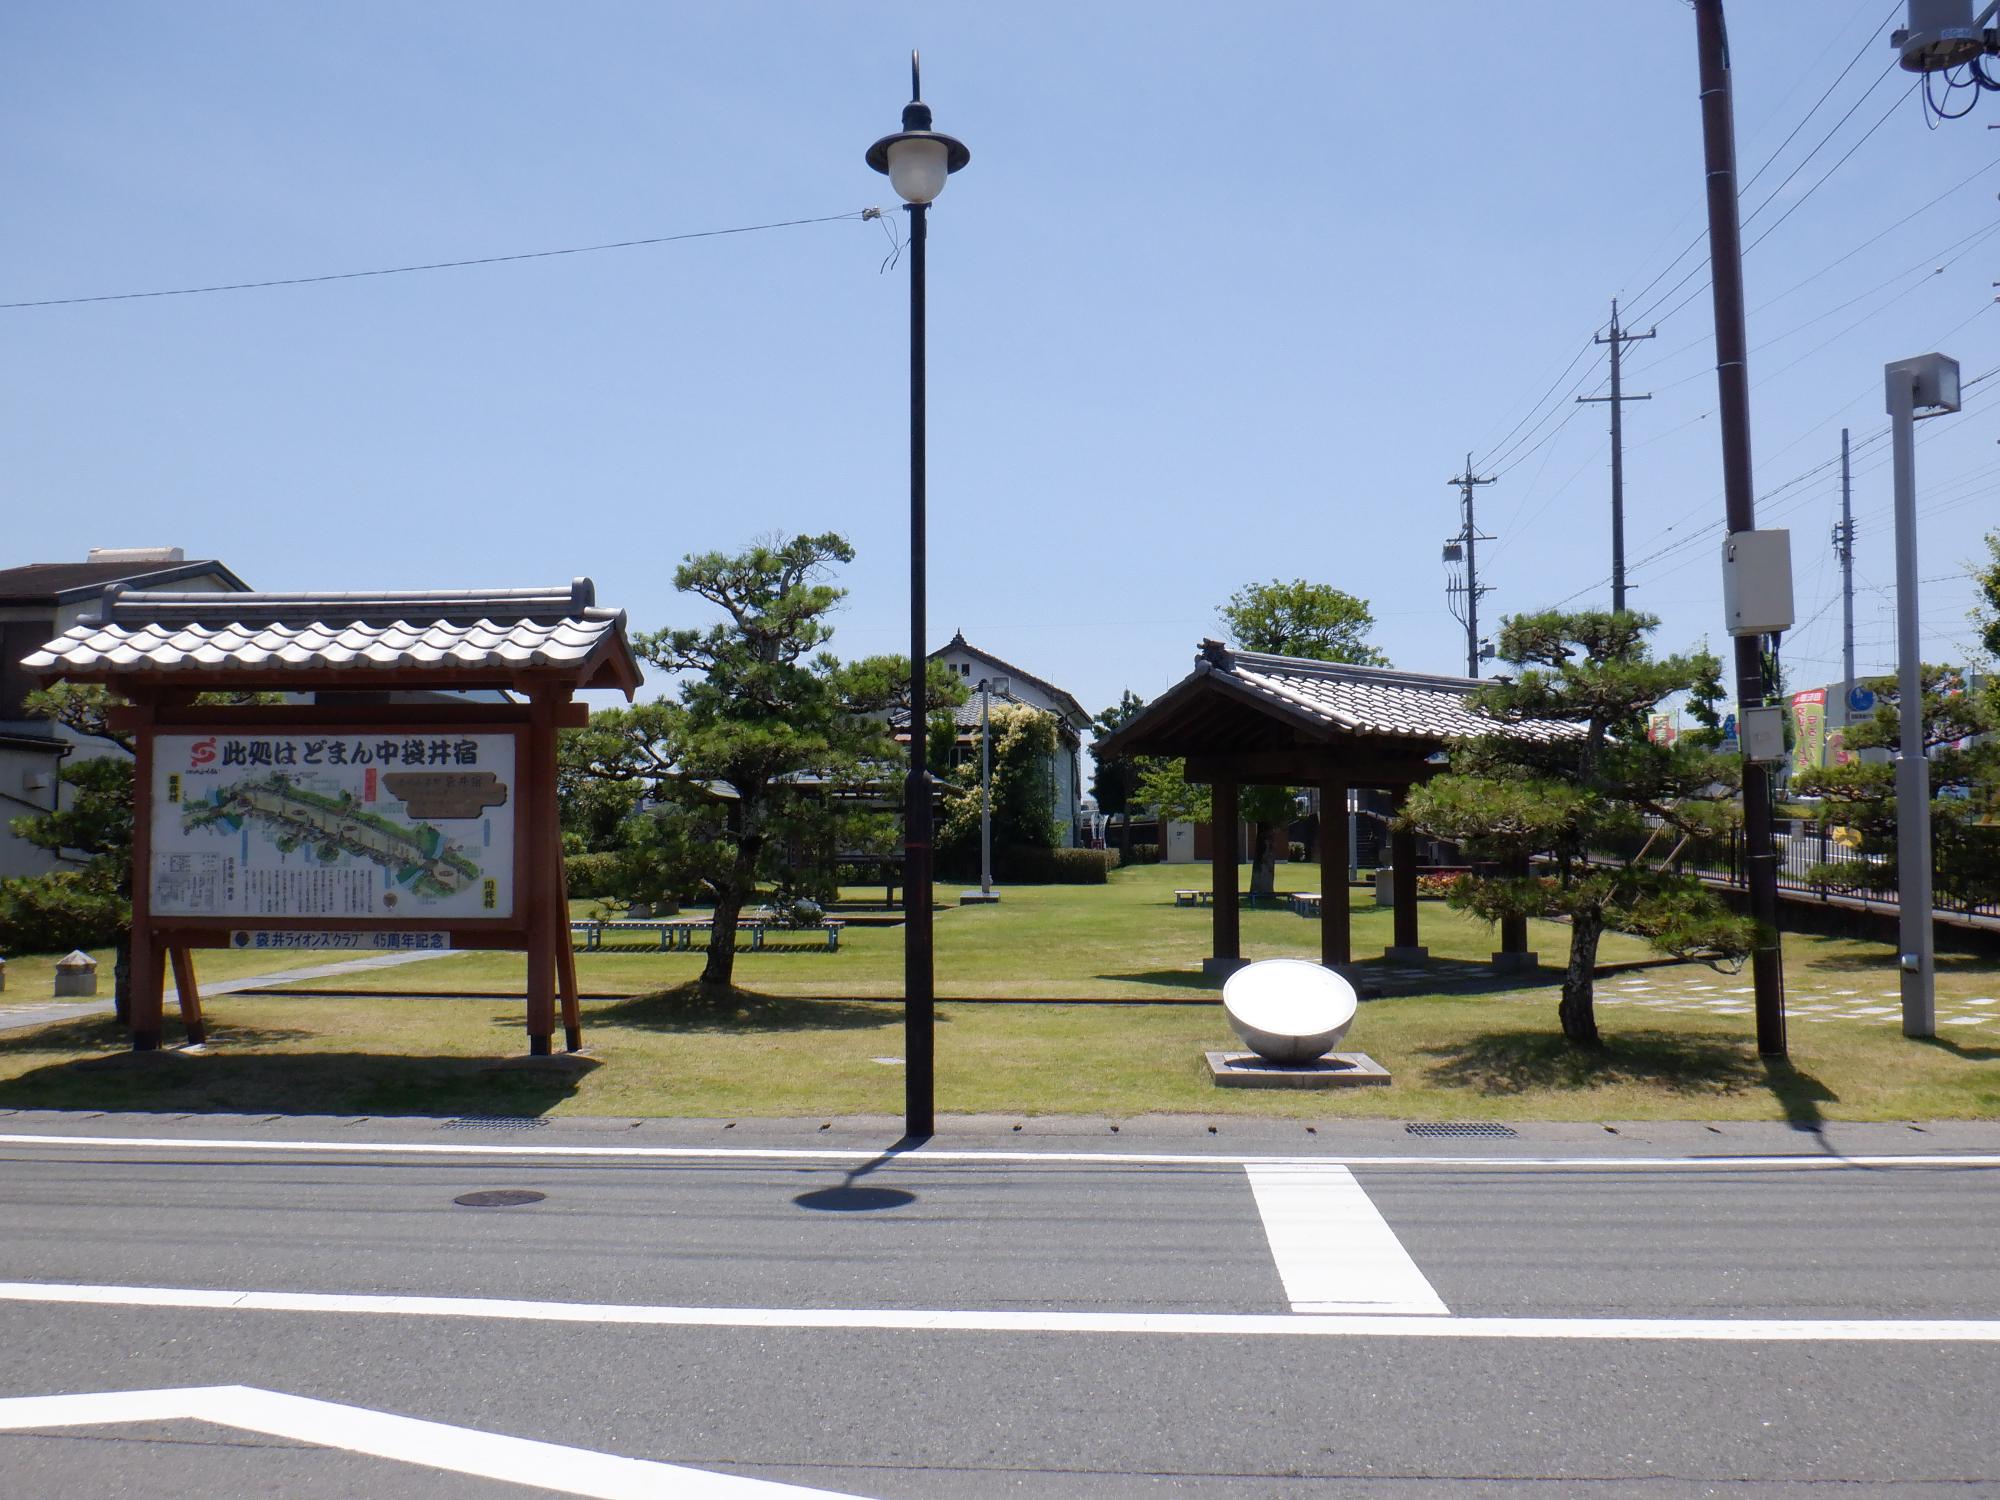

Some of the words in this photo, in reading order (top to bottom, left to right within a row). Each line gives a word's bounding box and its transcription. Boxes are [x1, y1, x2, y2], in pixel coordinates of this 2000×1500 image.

[256, 932, 364, 948] 袋井ライオンズクラブ
[373, 933, 443, 949] 45周年記念
